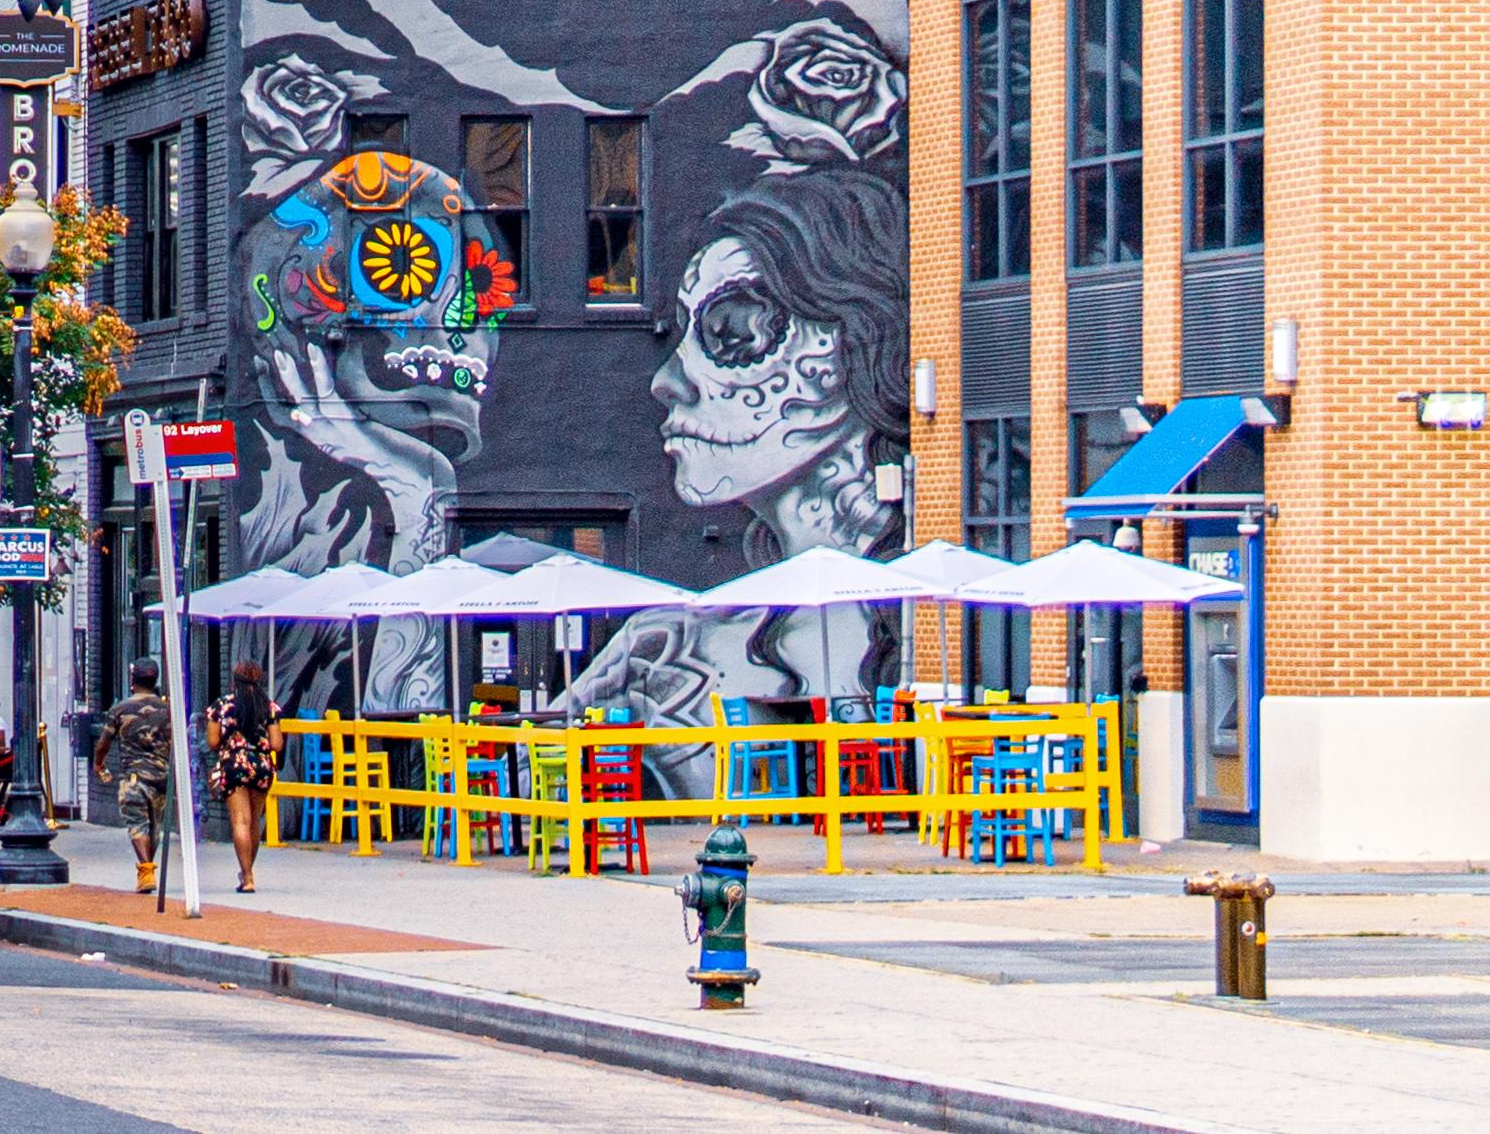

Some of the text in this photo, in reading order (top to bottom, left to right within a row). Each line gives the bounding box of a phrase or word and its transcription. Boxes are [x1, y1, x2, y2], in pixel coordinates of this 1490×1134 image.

[16, 32, 34, 40] THE
[163, 424, 223, 436] 92 Layover
[135, 428, 146, 480] metrobus
[1189, 551, 1229, 576] CHASE
